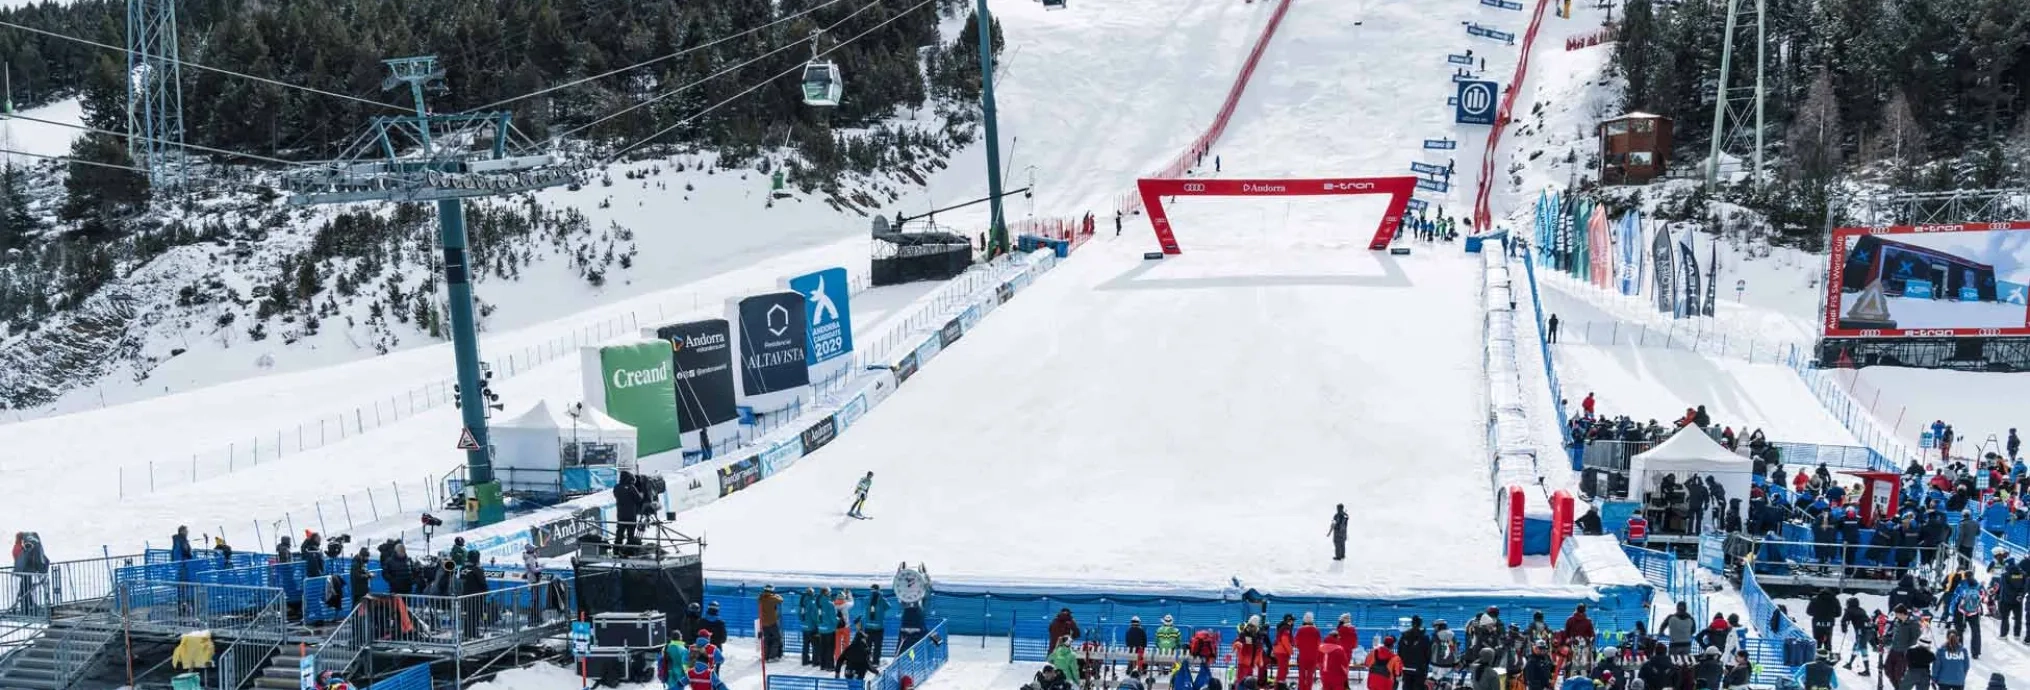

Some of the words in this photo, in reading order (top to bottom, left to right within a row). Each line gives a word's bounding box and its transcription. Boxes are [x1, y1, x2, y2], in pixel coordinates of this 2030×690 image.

[1251, 184, 1286, 193] Andorra
[1324, 182, 1375, 191] e-tron
[1914, 224, 1964, 233] e-tron
[1834, 235, 1844, 254] Cup
[1833, 254, 1842, 280] World
[1830, 294, 1838, 308] FIS
[1828, 309, 1837, 330] Audi
[686, 333, 726, 348] Andorra
[1904, 329, 1954, 337] e-tron
[815, 336, 843, 357] 2029
[747, 347, 805, 370] ALTAVISTA
[613, 361, 668, 388] Creand
[1945, 652, 1965, 661] USA
